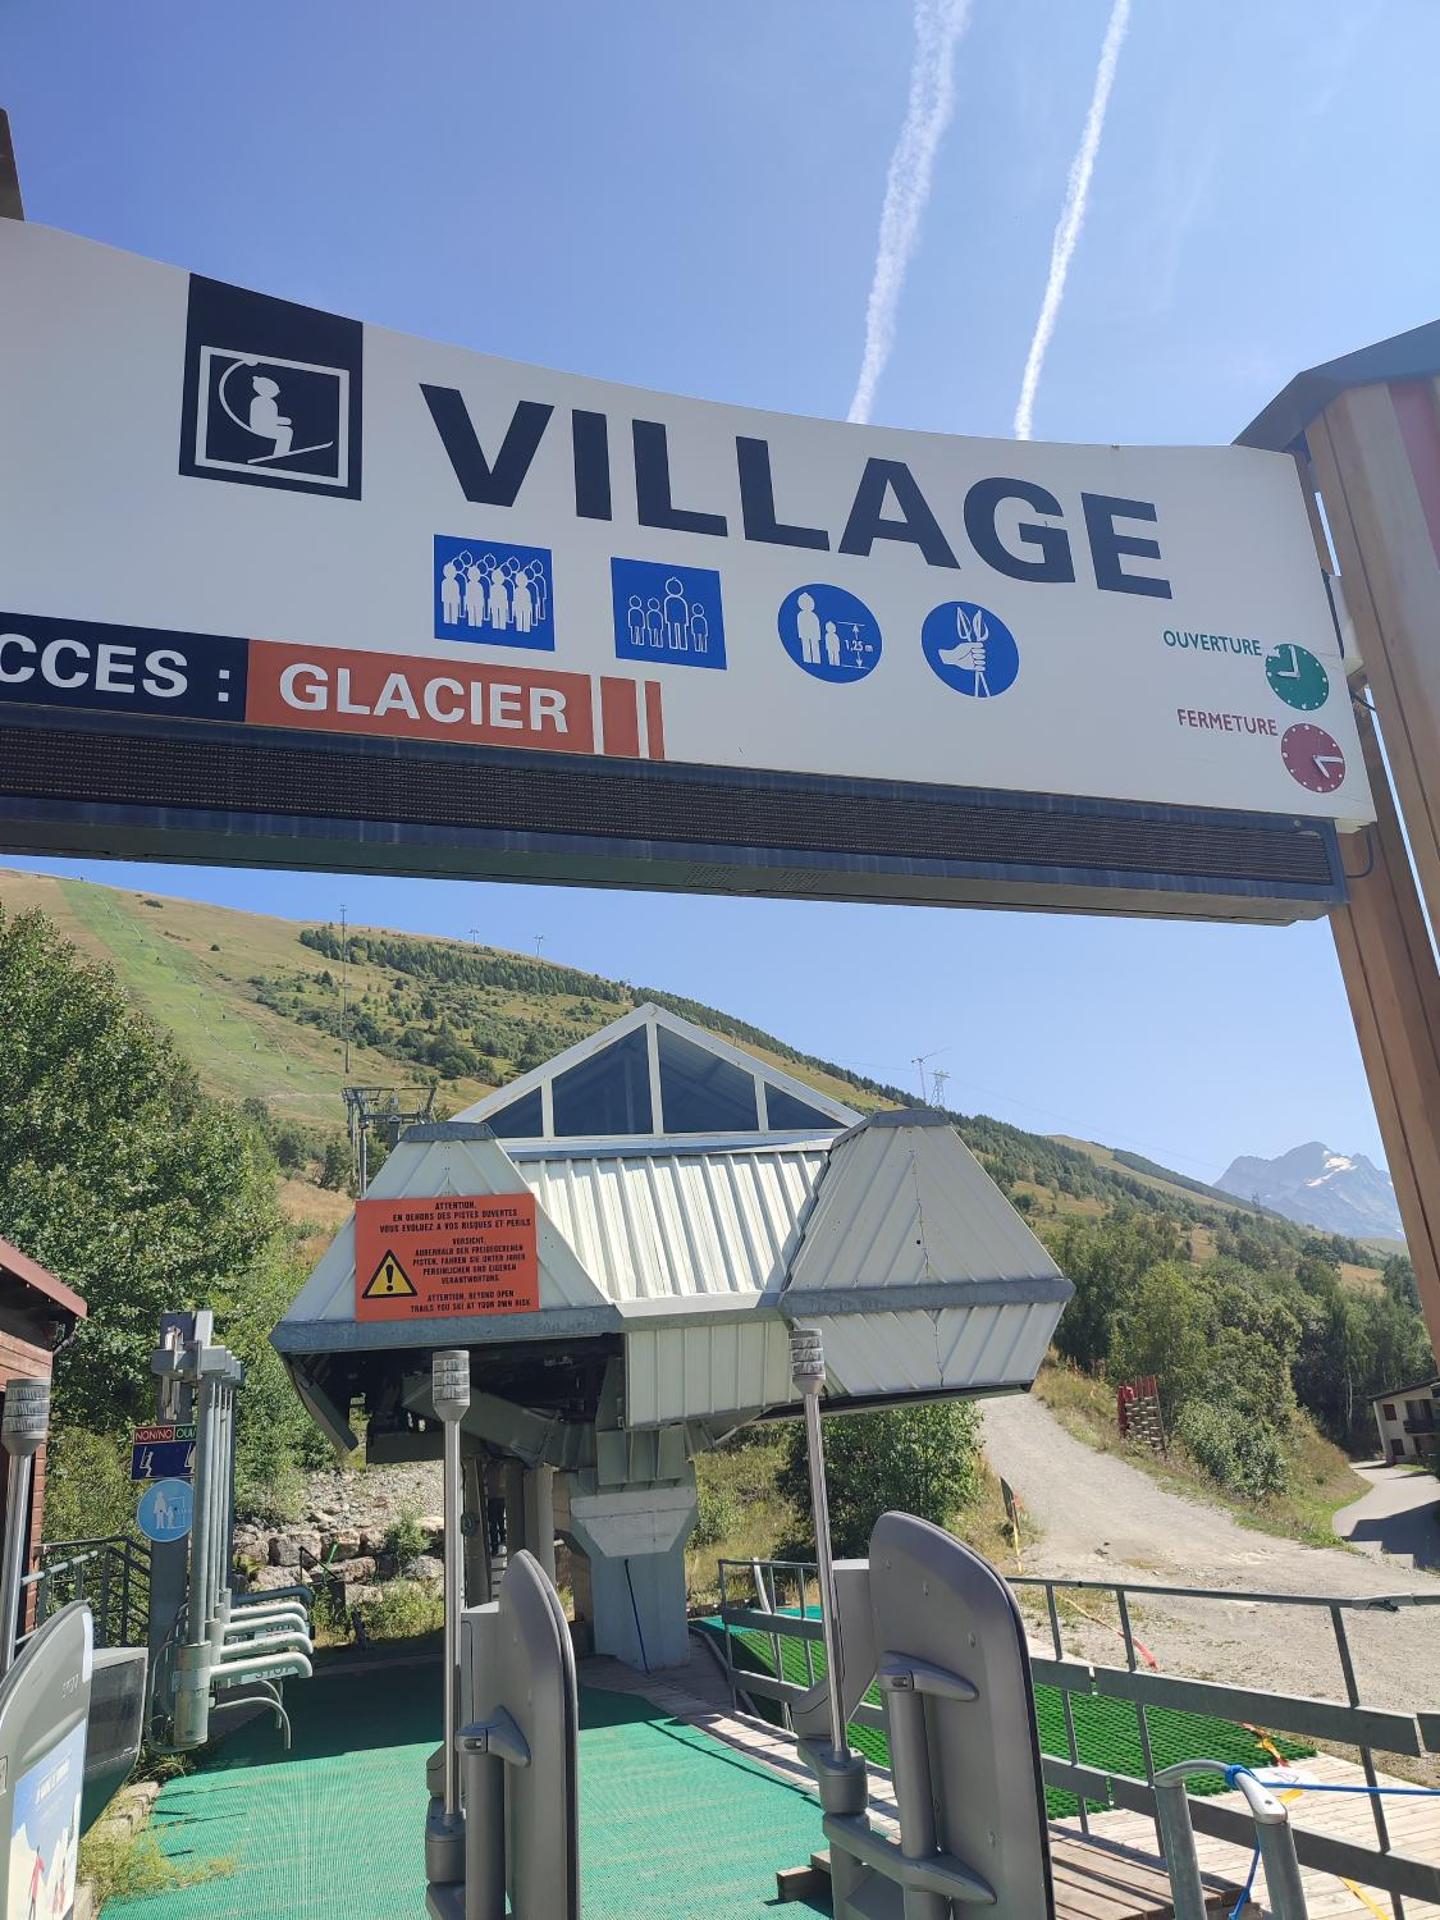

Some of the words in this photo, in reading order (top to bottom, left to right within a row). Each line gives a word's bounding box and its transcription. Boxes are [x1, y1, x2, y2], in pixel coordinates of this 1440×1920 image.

[419, 383, 1172, 600] VILLAGE
[1163, 630, 1262, 656] OUVERTURE
[279, 662, 568, 734] GLACIER
[1177, 708, 1278, 737] FERMETURE
[393, 1213, 403, 1222] EN
[406, 1212, 434, 1222] DEHORS
[437, 1211, 451, 1220] DES
[454, 1210, 479, 1220] PISTES
[482, 1208, 517, 1218] OUVERTES
[380, 1225, 399, 1233] VOUS
[402, 1223, 432, 1232] EVOLUEZ
[445, 1222, 459, 1230] VOS
[462, 1220, 492, 1230] RISQUES
[495, 1220, 504, 1229] ET
[507, 1218, 531, 1228] PERILS
[497, 1290, 514, 1299] OPEN
[411, 1304, 434, 1313] TRAILS
[437, 1303, 450, 1312] YOU
